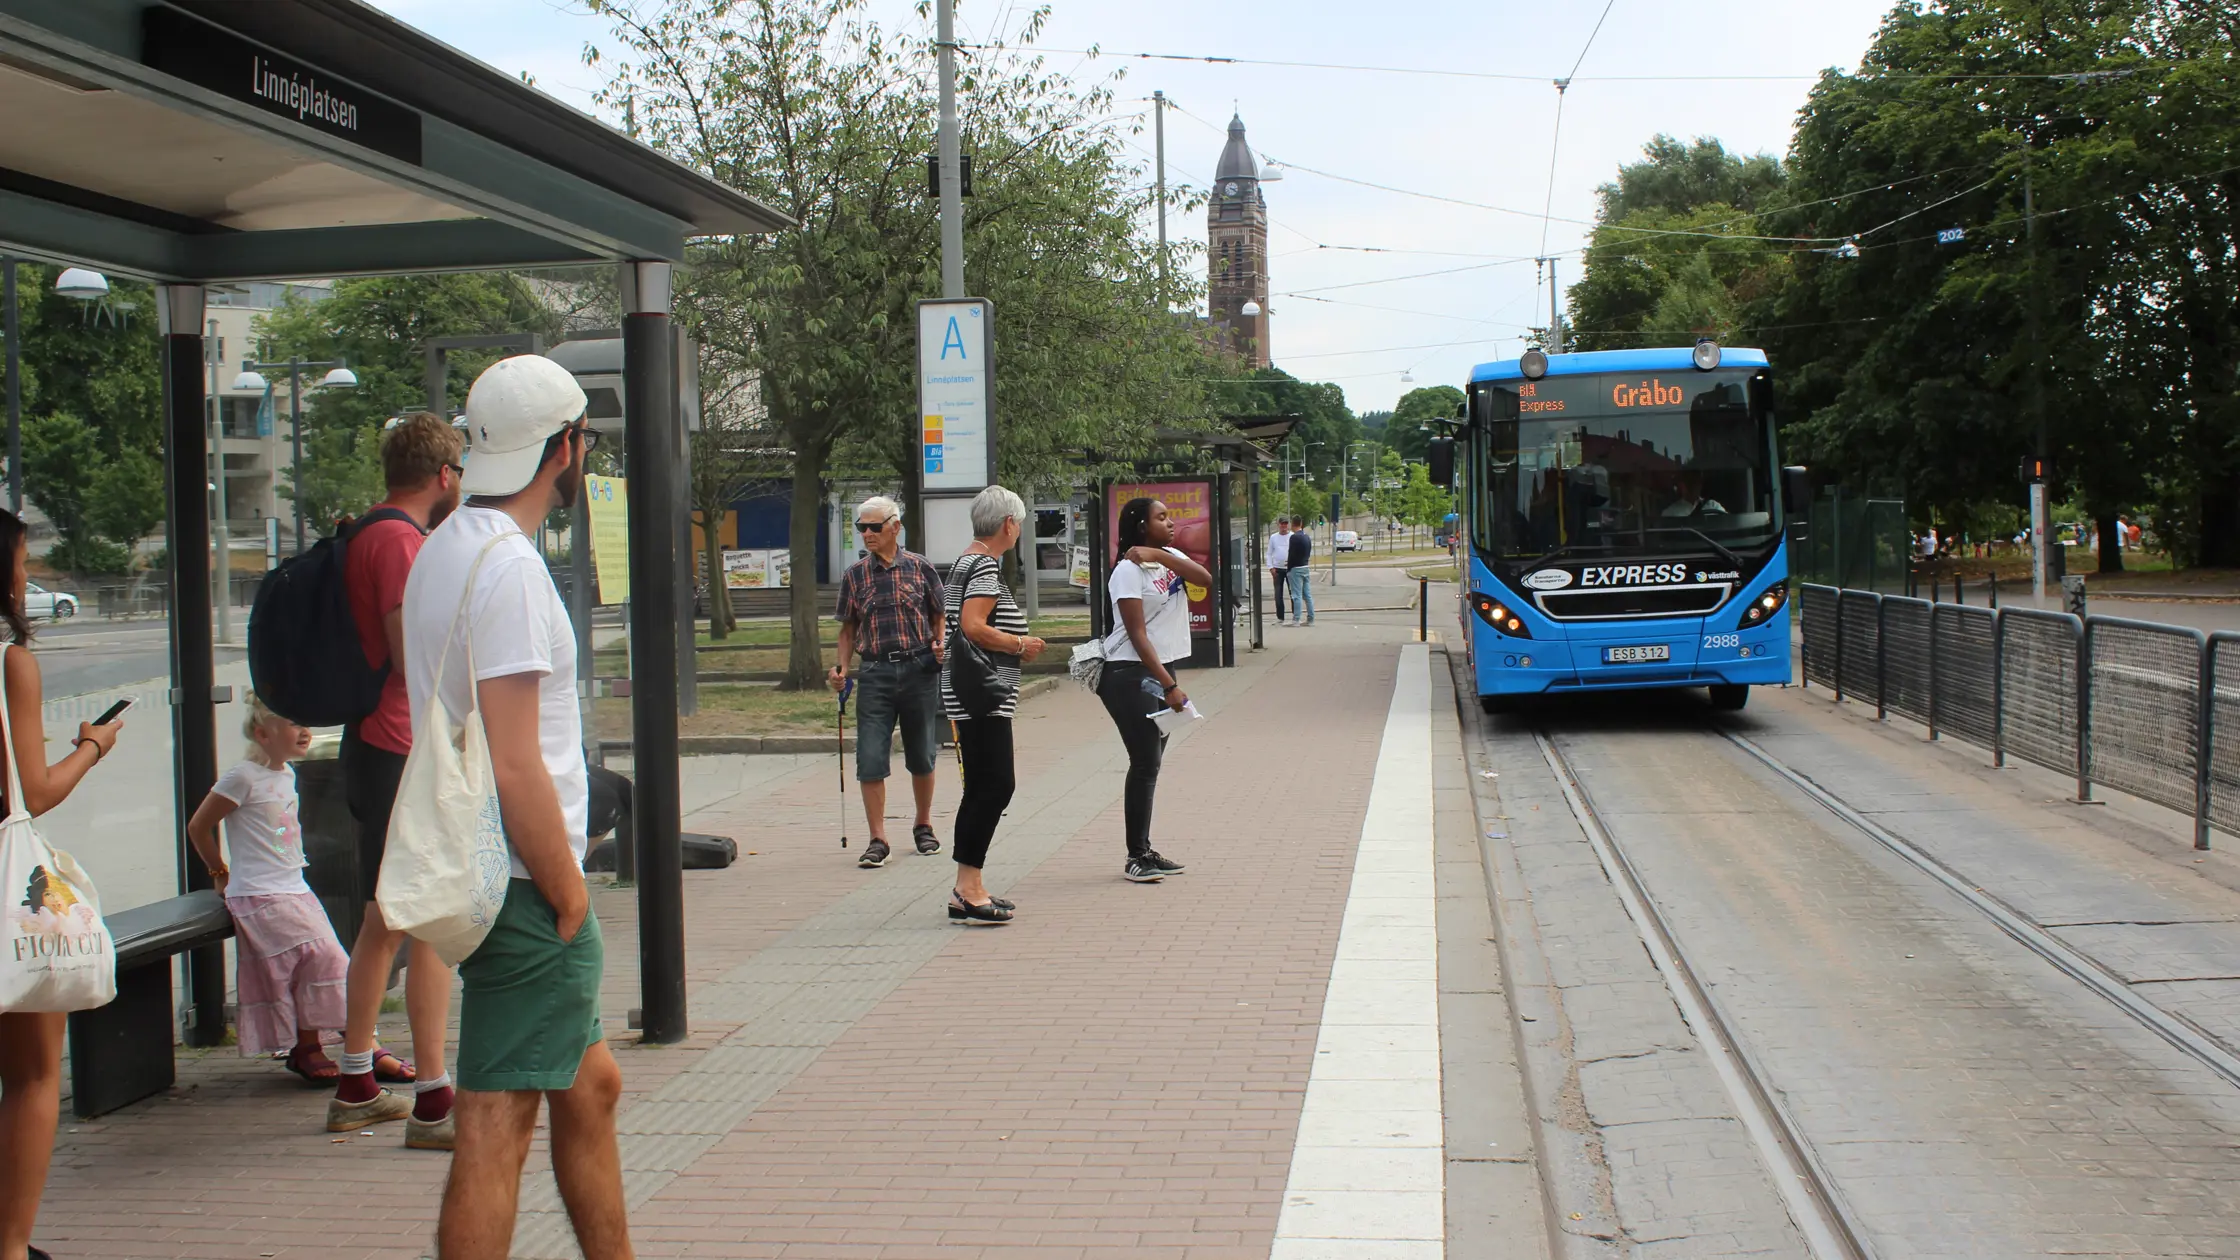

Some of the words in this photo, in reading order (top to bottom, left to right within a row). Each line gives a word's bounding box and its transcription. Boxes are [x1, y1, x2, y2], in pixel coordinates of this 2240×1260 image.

[253, 55, 357, 131] Linnéplatsen
[1940, 229, 1964, 242] 202
[940, 315, 967, 361] A
[926, 375, 974, 384] Linnéplatsen
[1519, 383, 1536, 397] Blå
[1613, 378, 1684, 408] Gråbo
[1519, 400, 1565, 413] Express
[930, 447, 942, 457] Blå
[1166, 487, 1203, 504] surf
[1581, 563, 1687, 586] EXPRESS
[1708, 571, 1740, 579] västtrafik
[1703, 634, 1739, 649] 2988
[1613, 648, 1636, 660] ESB
[1640, 647, 1664, 658] 312
